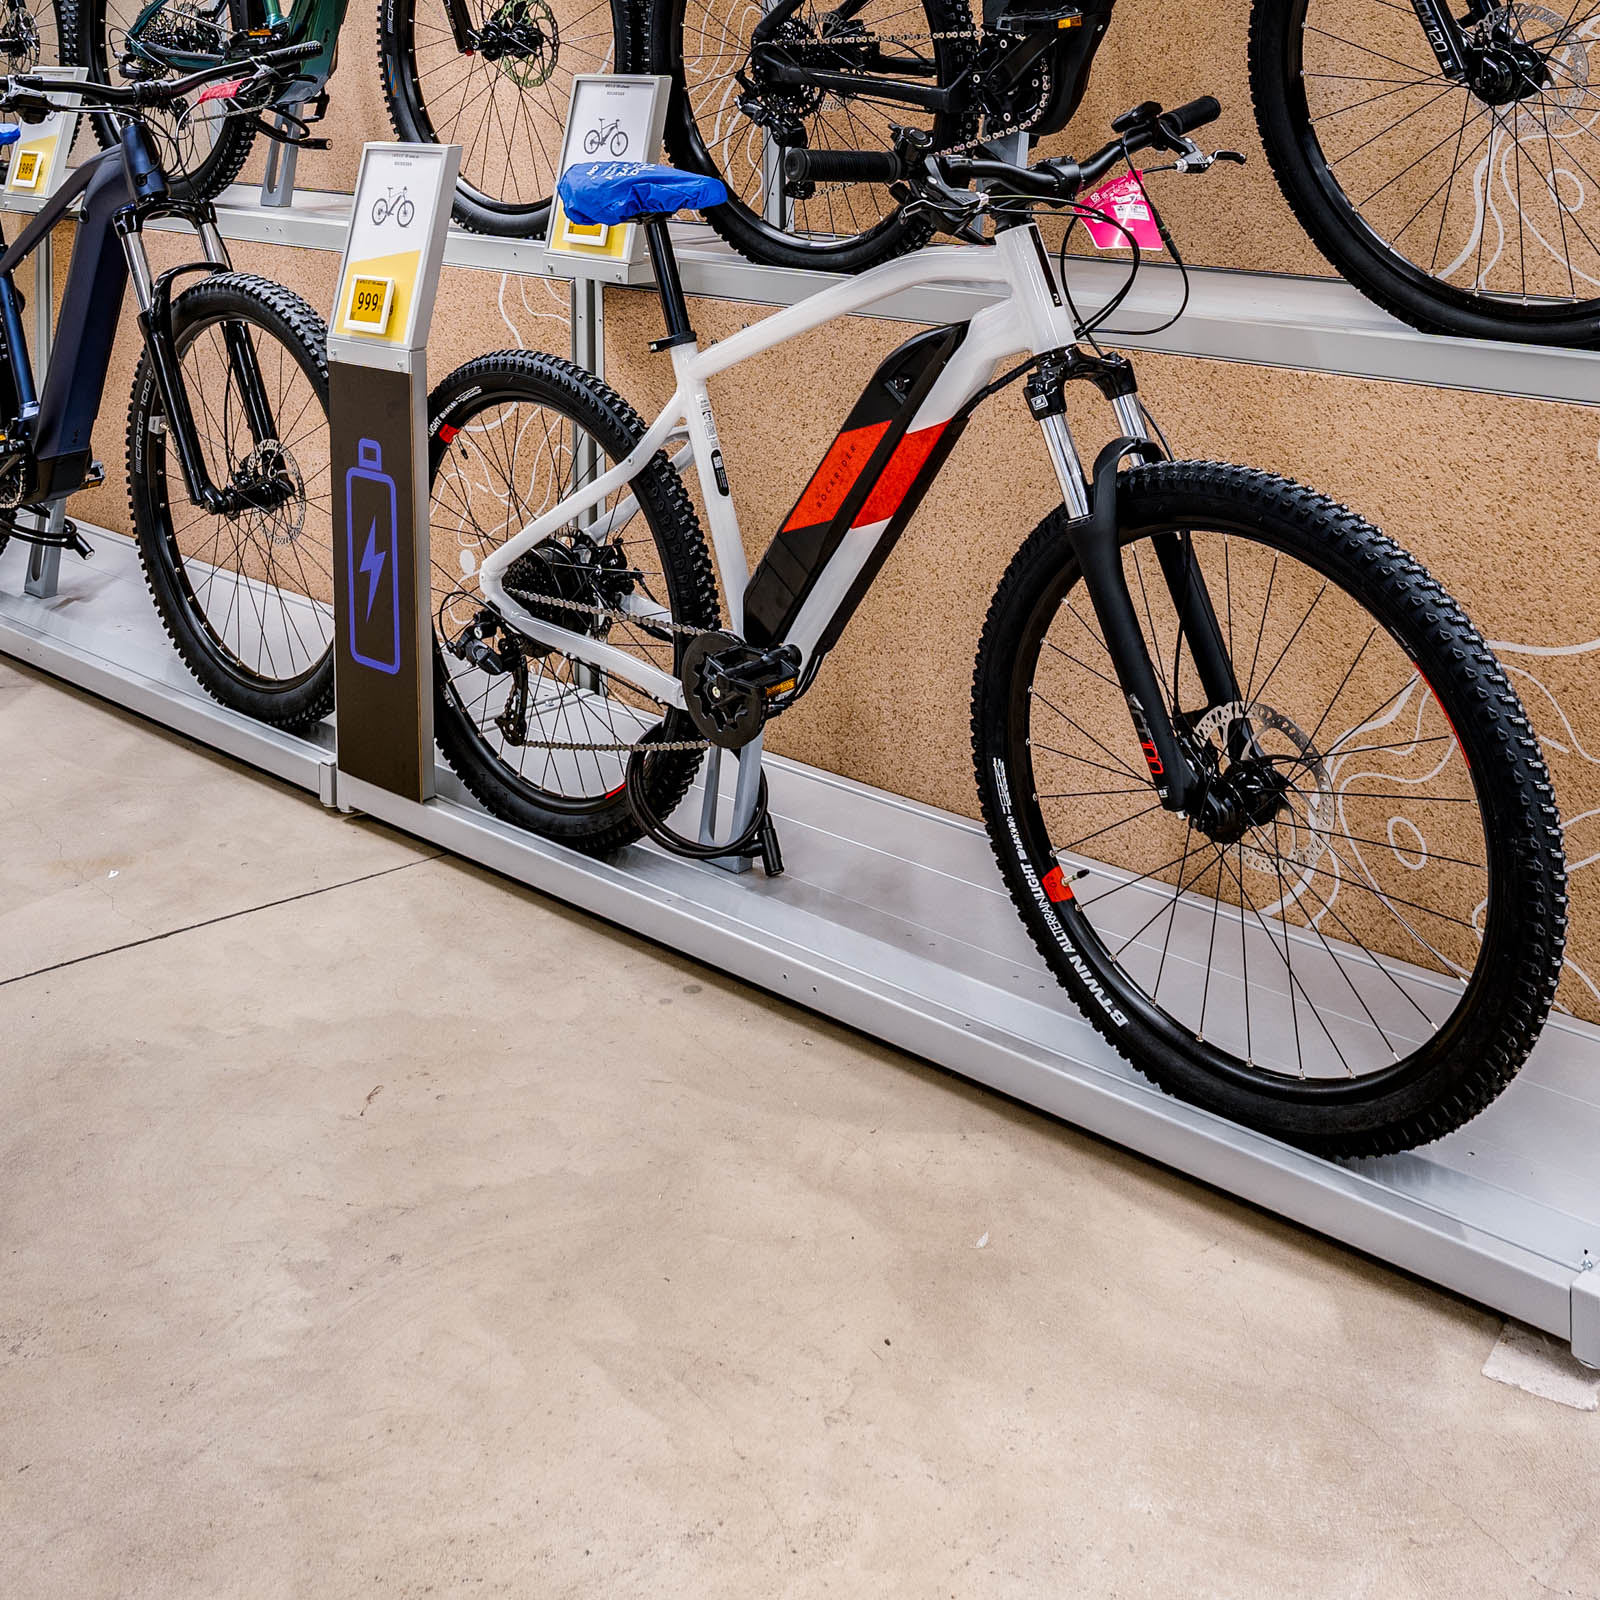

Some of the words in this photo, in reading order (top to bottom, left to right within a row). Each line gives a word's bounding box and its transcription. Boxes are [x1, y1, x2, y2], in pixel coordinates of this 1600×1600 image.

[357, 291, 379, 312] 999
[134, 416, 145, 462] GRIP
[140, 382, 152, 414] 100
[816, 444, 856, 509] ROCKRIDER
